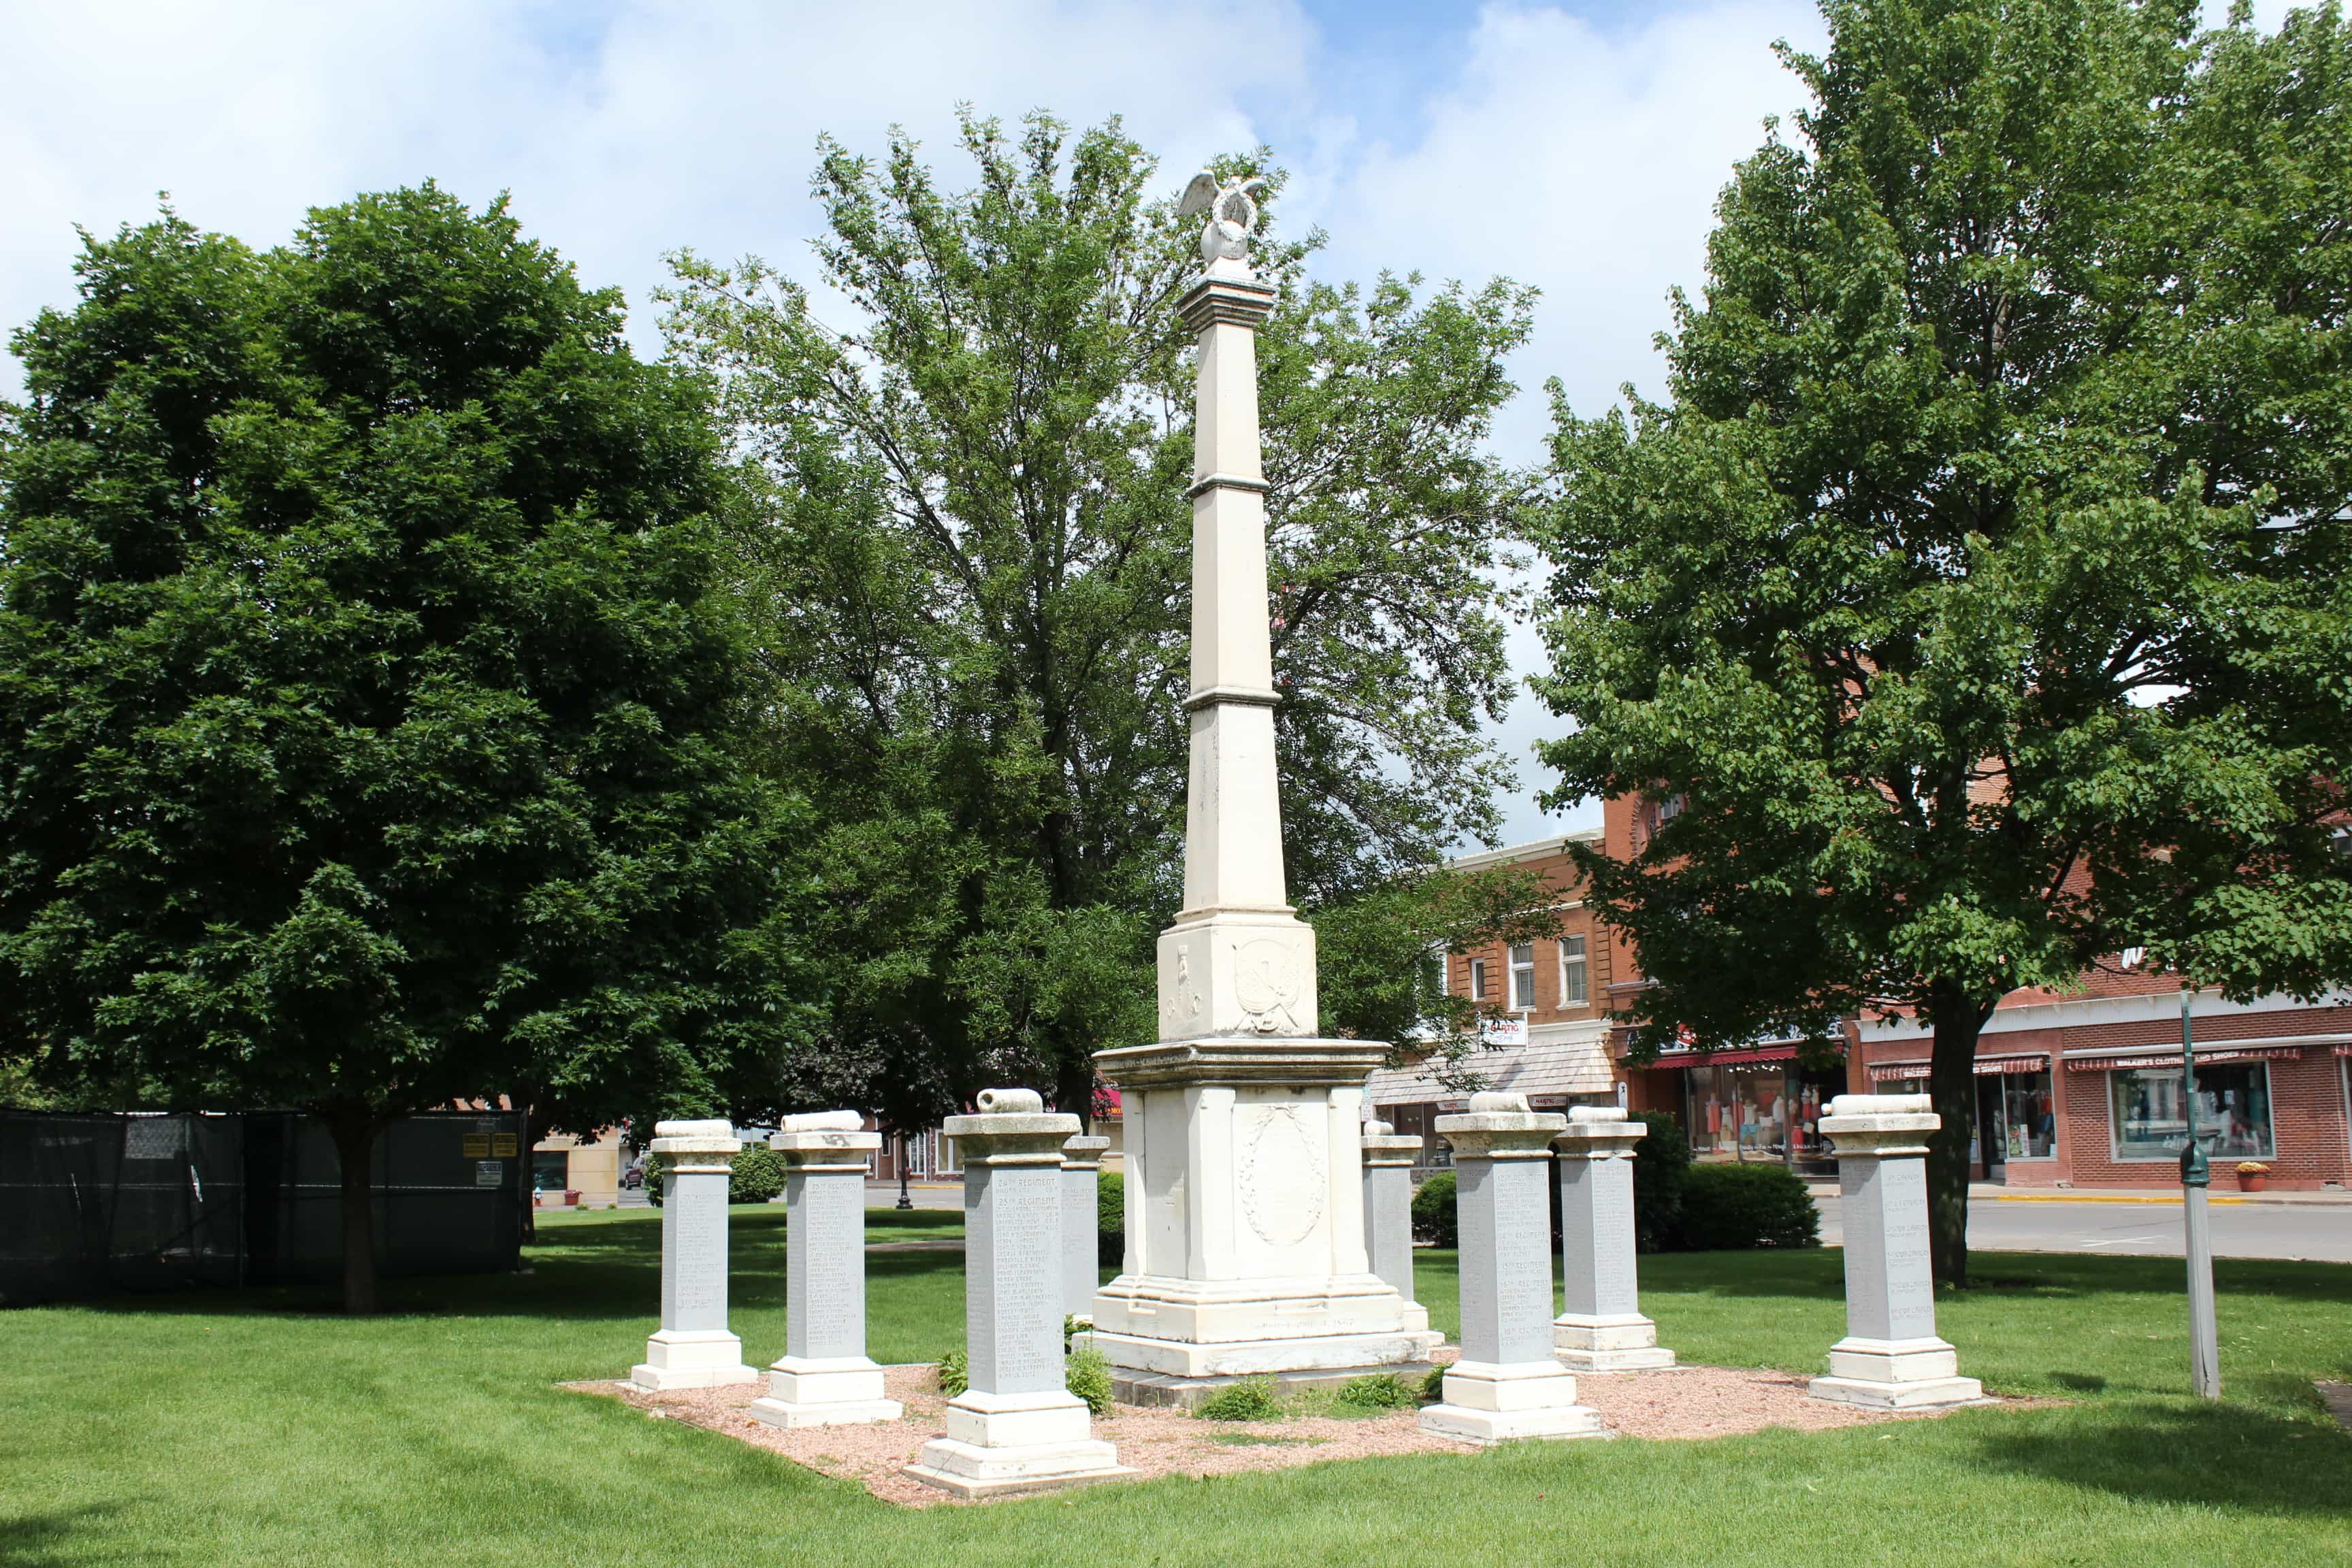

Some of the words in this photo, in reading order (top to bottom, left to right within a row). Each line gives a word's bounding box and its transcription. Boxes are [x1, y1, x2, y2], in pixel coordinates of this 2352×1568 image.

[2155, 1056, 2185, 1064] CLOTHIN
[1018, 1178, 1056, 1187] REGIMENT
[1018, 1197, 1055, 1206] REGIMENT
